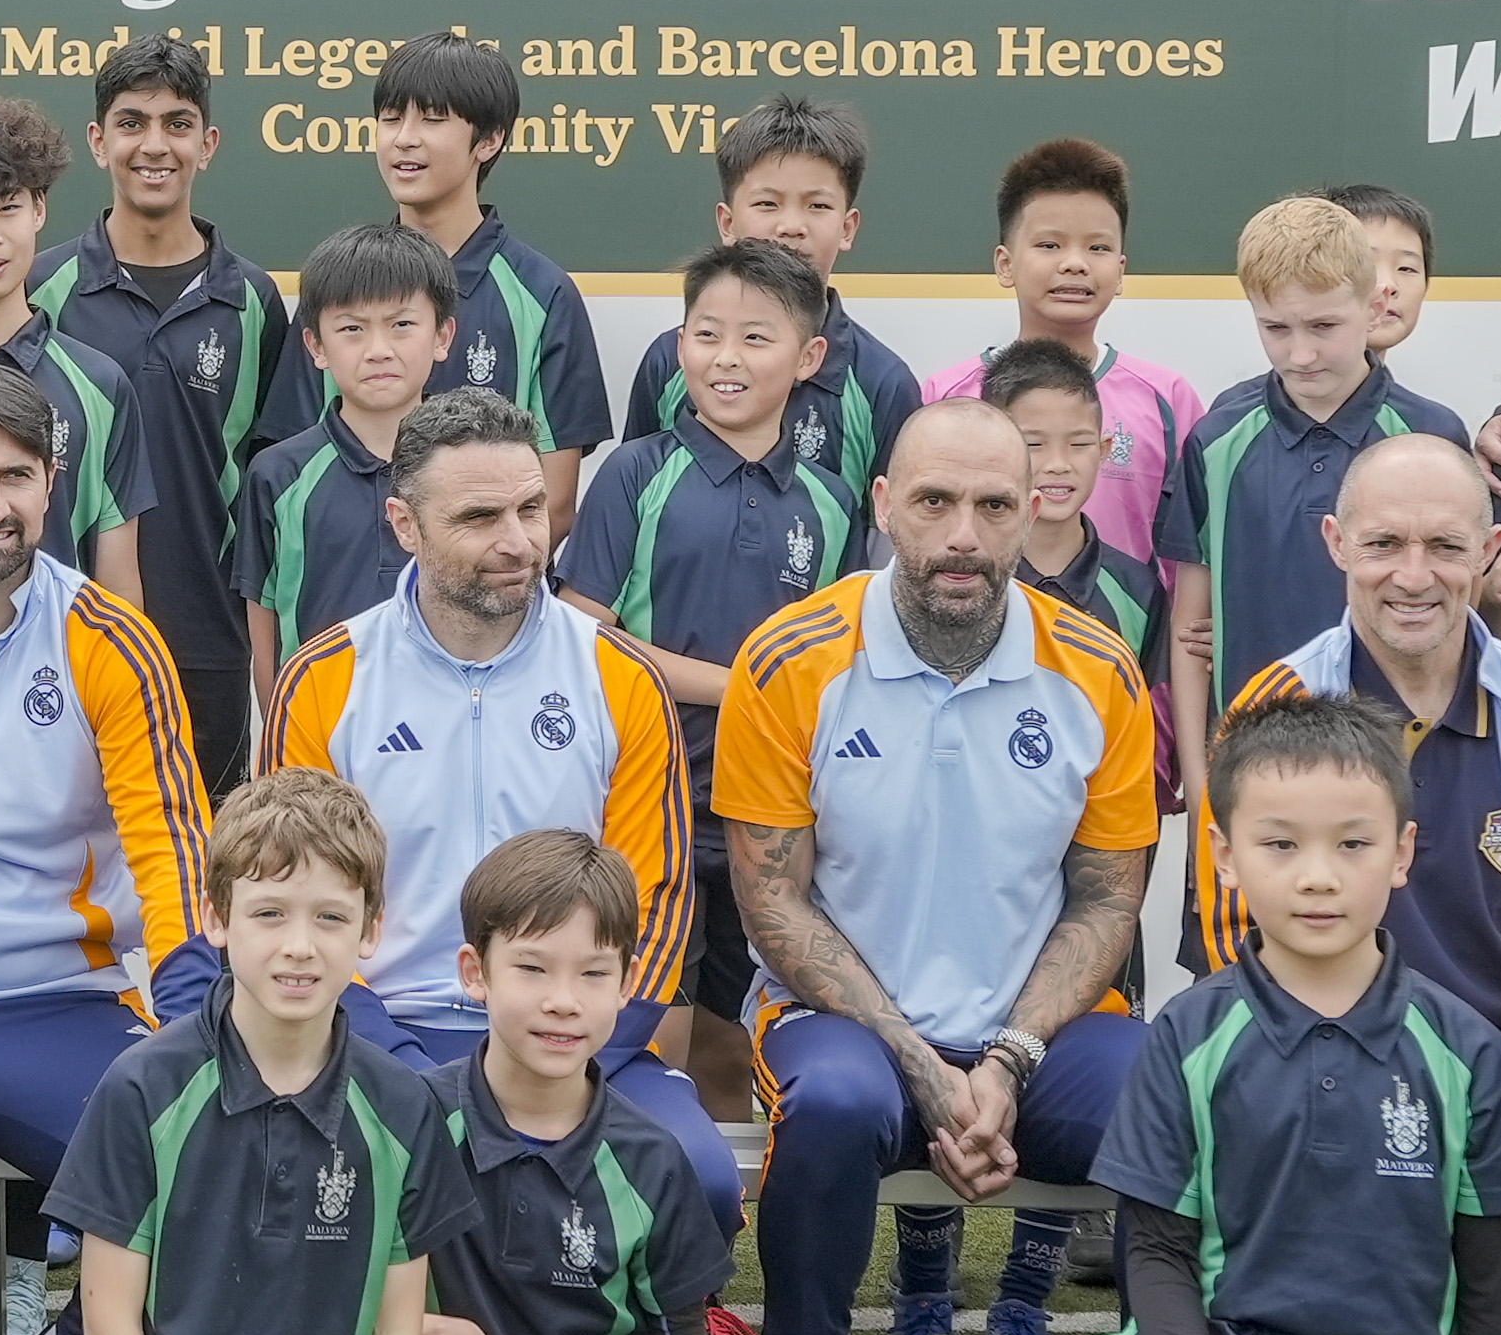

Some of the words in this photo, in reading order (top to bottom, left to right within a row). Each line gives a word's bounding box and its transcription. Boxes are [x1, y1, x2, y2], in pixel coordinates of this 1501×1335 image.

[1, 25, 225, 76] Madd
[245, 25, 500, 90] Lege
[521, 25, 637, 77] and
[658, 25, 977, 77] Barcelona
[996, 27, 1224, 77] Heroes
[1376, 1157, 1434, 1173] MALVERN
[305, 1224, 350, 1235] MALVERN
